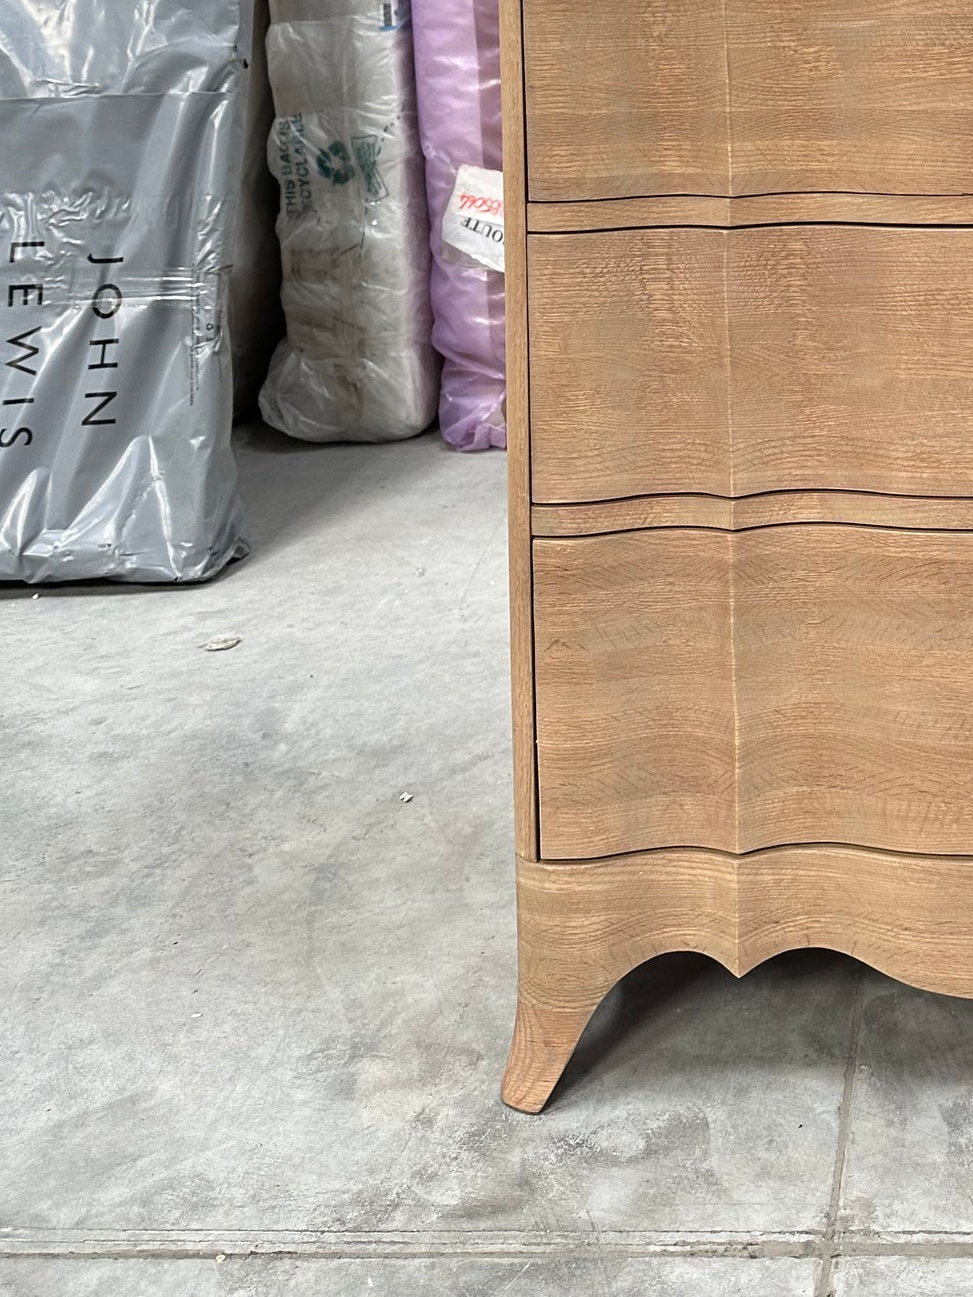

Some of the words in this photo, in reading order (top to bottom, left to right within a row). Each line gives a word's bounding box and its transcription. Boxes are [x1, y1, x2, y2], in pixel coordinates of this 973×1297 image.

[285, 180, 298, 215] THIS
[0, 241, 45, 449] LEWIS
[81, 253, 124, 426] JOHN
